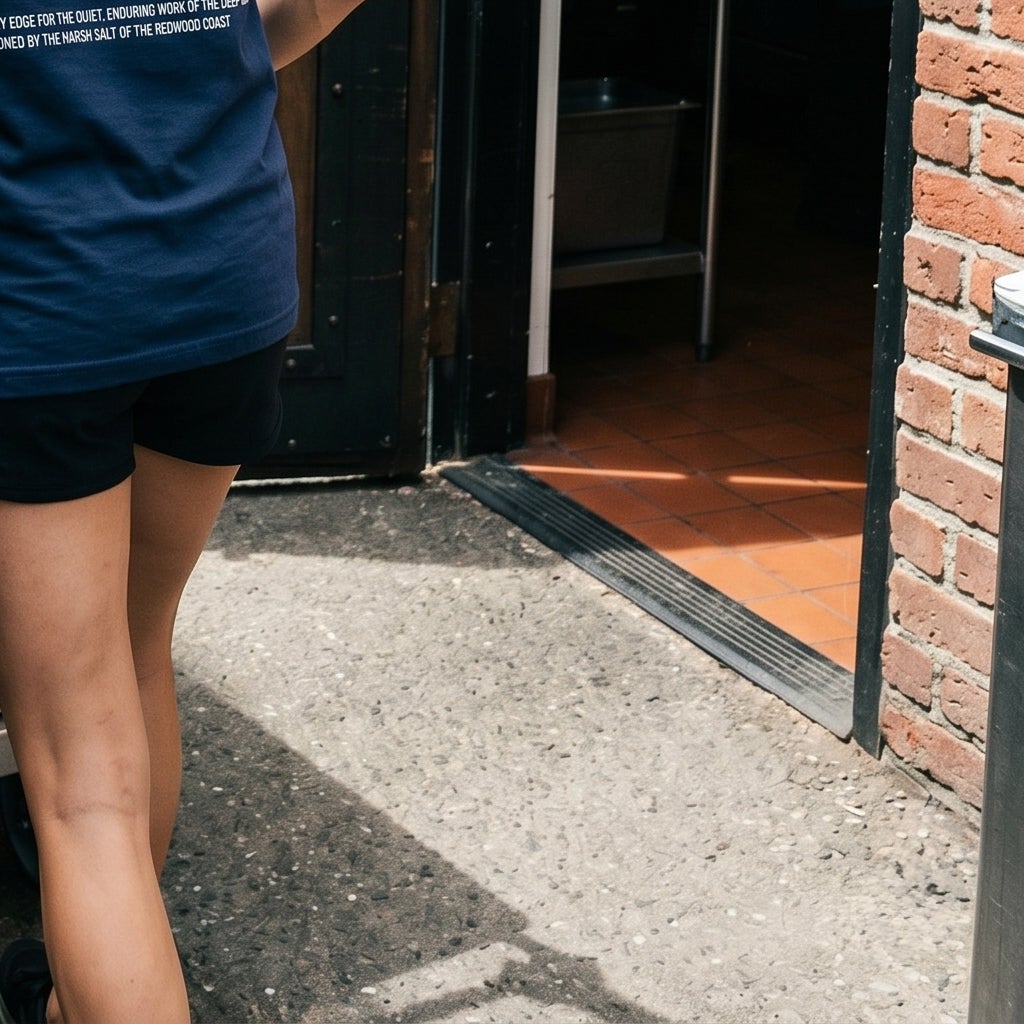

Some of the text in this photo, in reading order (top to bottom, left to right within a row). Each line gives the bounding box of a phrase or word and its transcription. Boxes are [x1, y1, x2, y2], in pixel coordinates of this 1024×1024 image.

[9, 14, 36, 29] EDGE
[38, 13, 56, 27] FOR
[56, 11, 75, 25] THE
[106, 4, 156, 21] ENDURING
[157, 0, 186, 16] WORK
[187, 0, 200, 13] OF
[27, 34, 40, 48] BY
[42, 32, 61, 46] THE
[94, 27, 117, 41] SALT
[119, 25, 132, 39] OF
[133, 24, 153, 37] THE
[155, 18, 201, 35] REDWOOD
[202, 14, 231, 30] COAST
